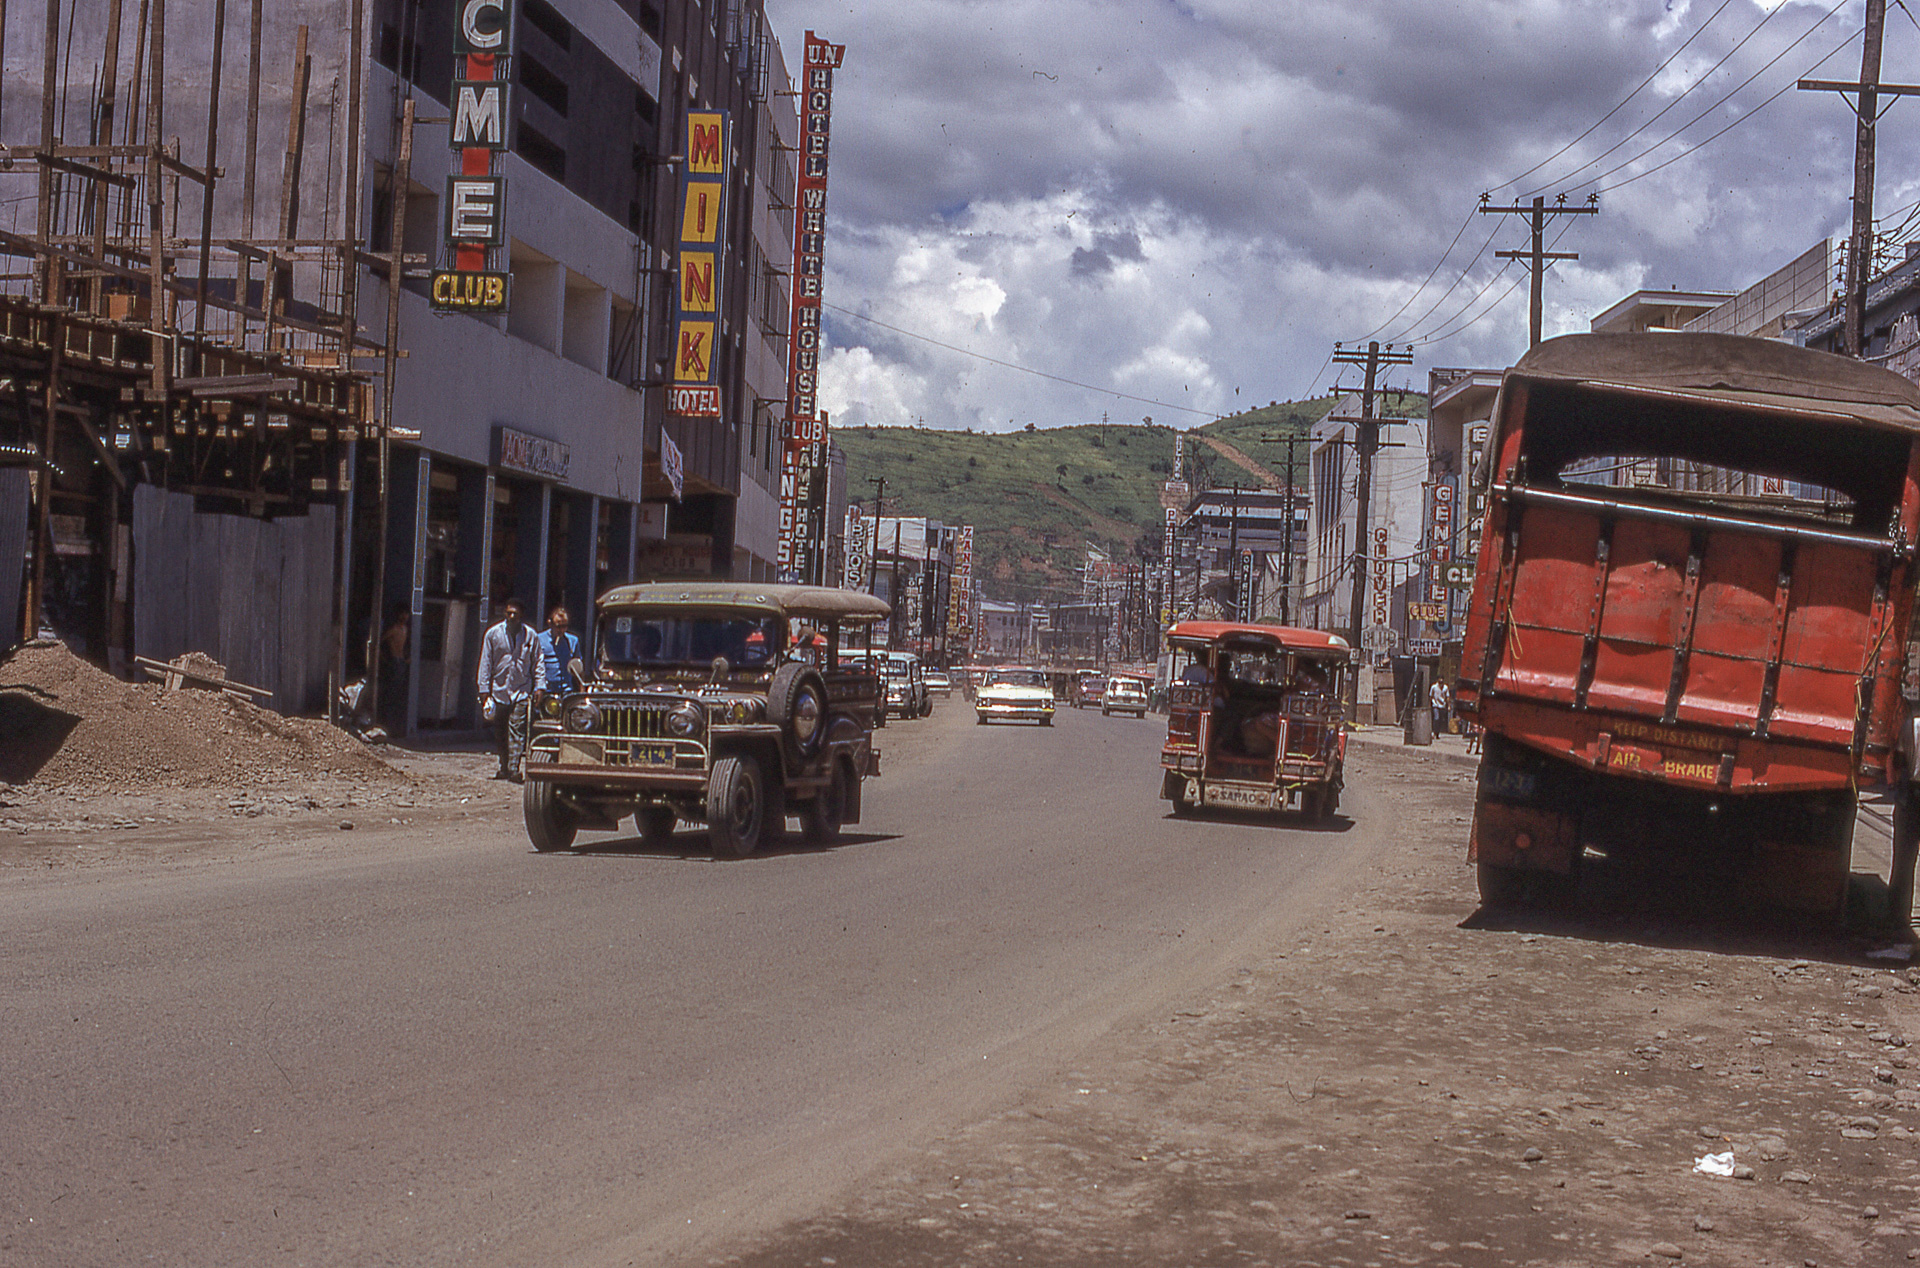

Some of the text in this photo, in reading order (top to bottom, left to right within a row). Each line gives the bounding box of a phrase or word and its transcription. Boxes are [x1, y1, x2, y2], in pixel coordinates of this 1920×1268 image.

[681, 123, 720, 374] MINK
[798, 69, 828, 416] HOTEL WHITE HOUSE
[433, 274, 504, 306] CLUB
[667, 389, 718, 413] HOTEL
[781, 420, 824, 440] CLUB
[794, 508, 808, 584] HOTE
[960, 527, 973, 625] ZANZIBAR
[1373, 528, 1388, 624] CLOVER
[1410, 606, 1446, 618] CLUB
[1614, 721, 1727, 750] KEEP DISTANCE
[1613, 752, 1715, 780] AIR BRAKE
[1219, 789, 1257, 804] SARAO
